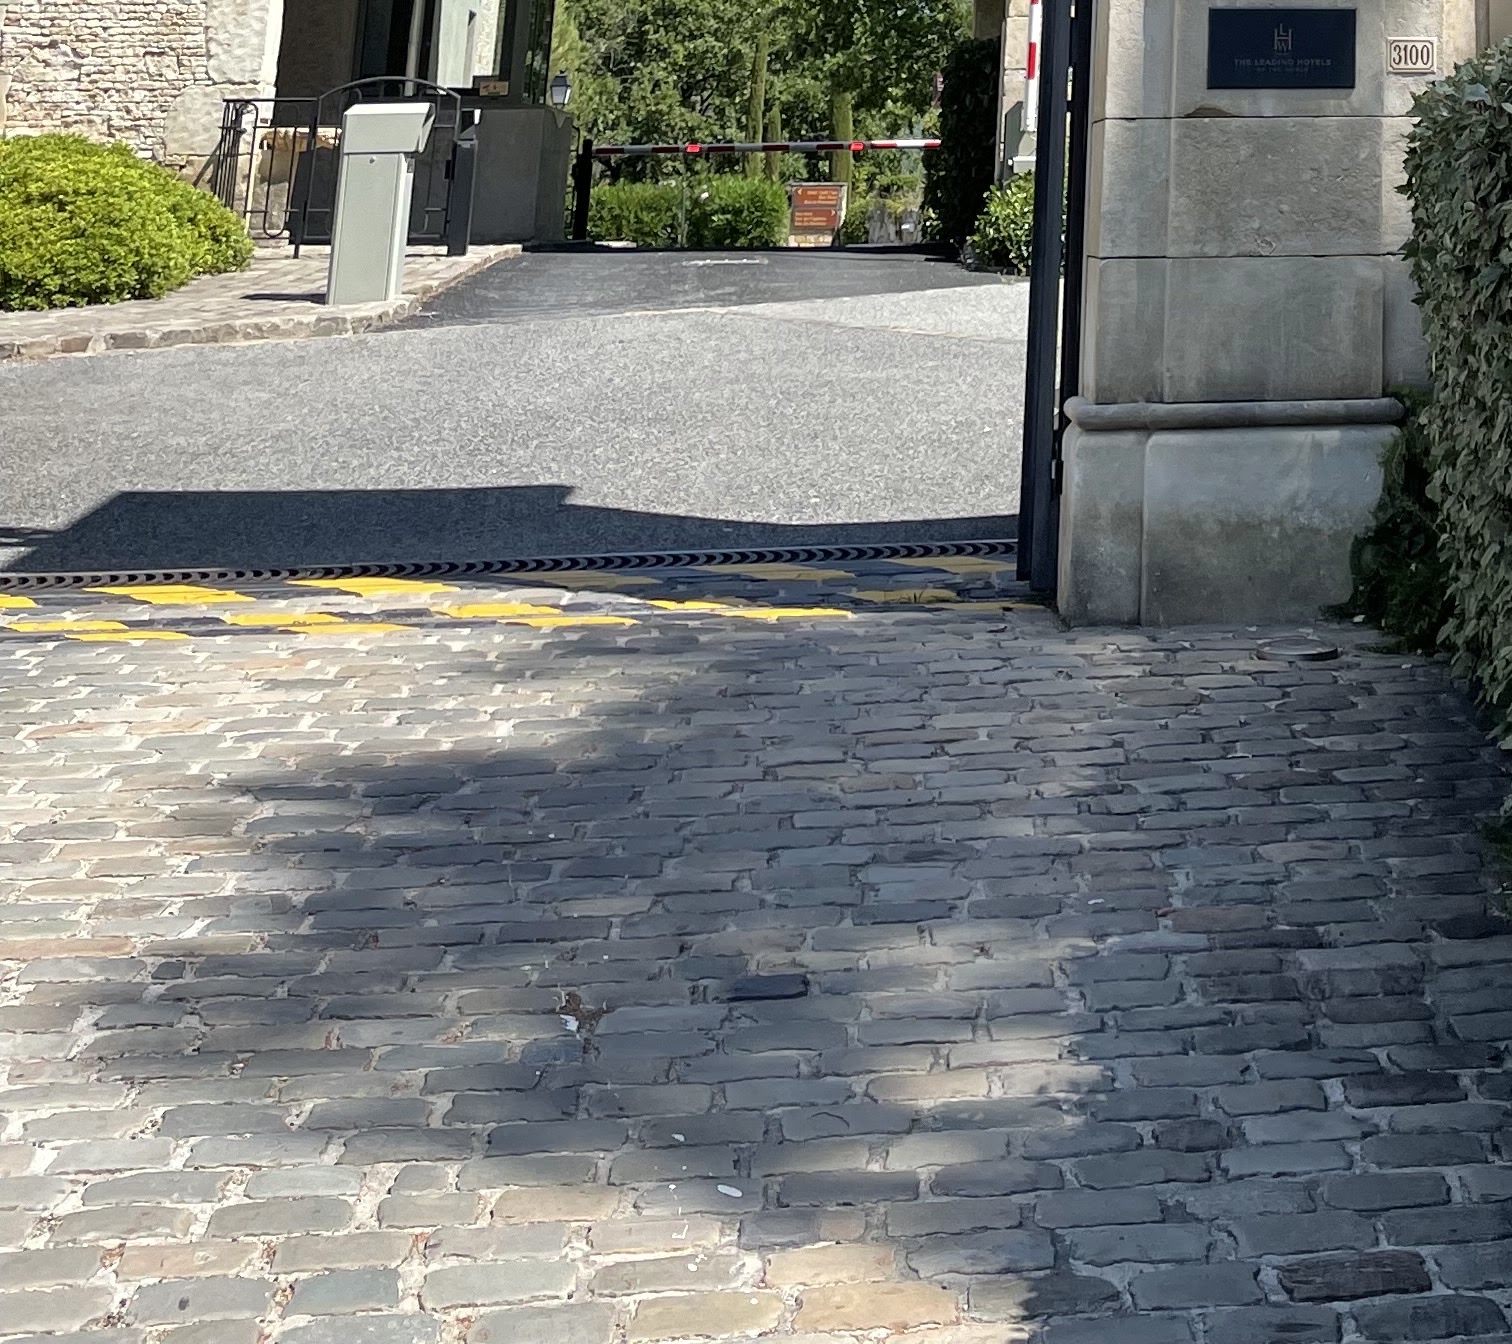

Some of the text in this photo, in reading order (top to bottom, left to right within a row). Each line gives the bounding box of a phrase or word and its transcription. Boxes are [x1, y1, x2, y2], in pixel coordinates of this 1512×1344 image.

[1234, 58, 1332, 66] THE LEADING HOTELS
[1392, 44, 1430, 66] 3100
